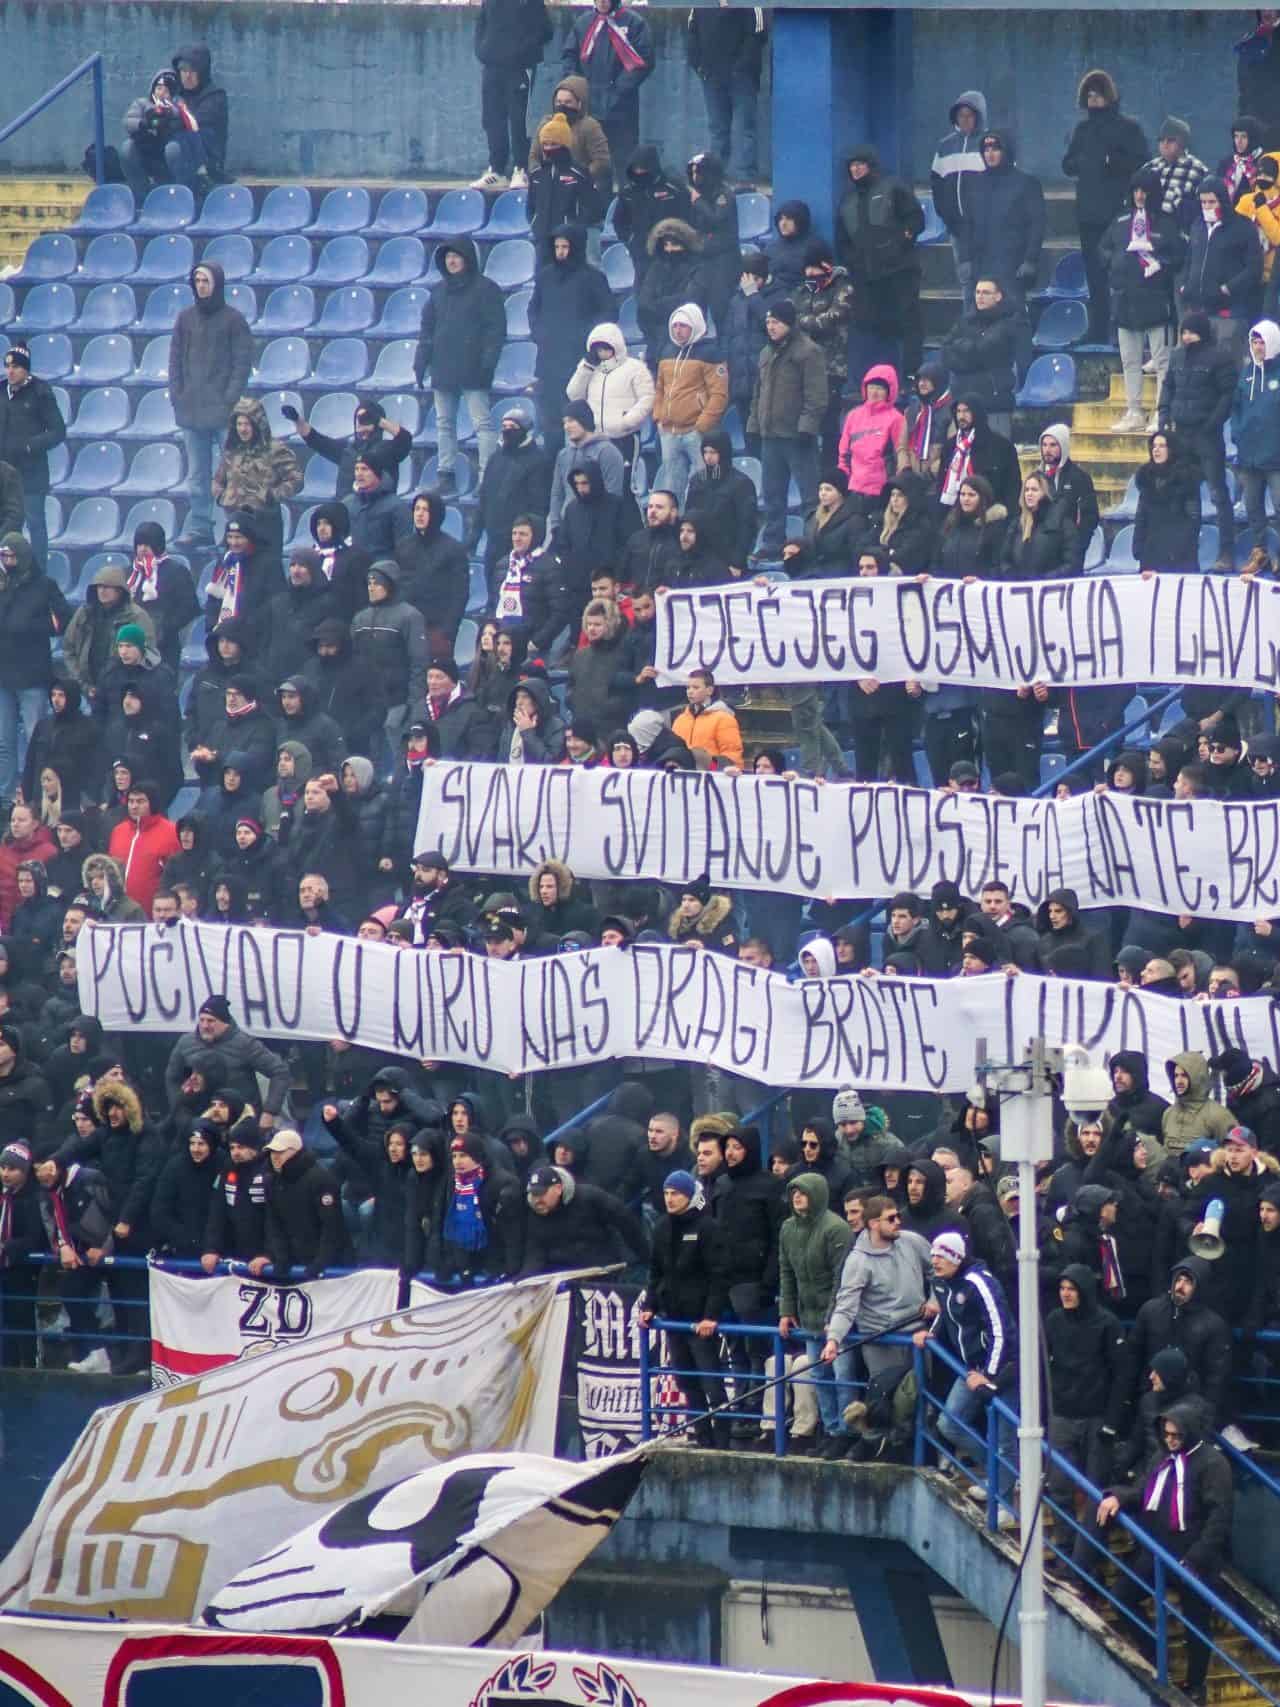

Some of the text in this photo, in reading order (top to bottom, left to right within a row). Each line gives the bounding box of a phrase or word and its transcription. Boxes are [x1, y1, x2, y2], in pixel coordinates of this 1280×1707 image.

[665, 587, 879, 673] DJEČJEG
[899, 577, 1124, 683] OSMIJEHA
[438, 766, 574, 870] SVAKO
[601, 769, 821, 891] SVITANJE
[333, 939, 363, 1040] U
[393, 950, 494, 1062] MIRU
[520, 952, 610, 1069] NAŠ
[631, 944, 775, 1073] DRAGI
[800, 976, 948, 1089] BRATE
[239, 1284, 313, 1338] ZD
